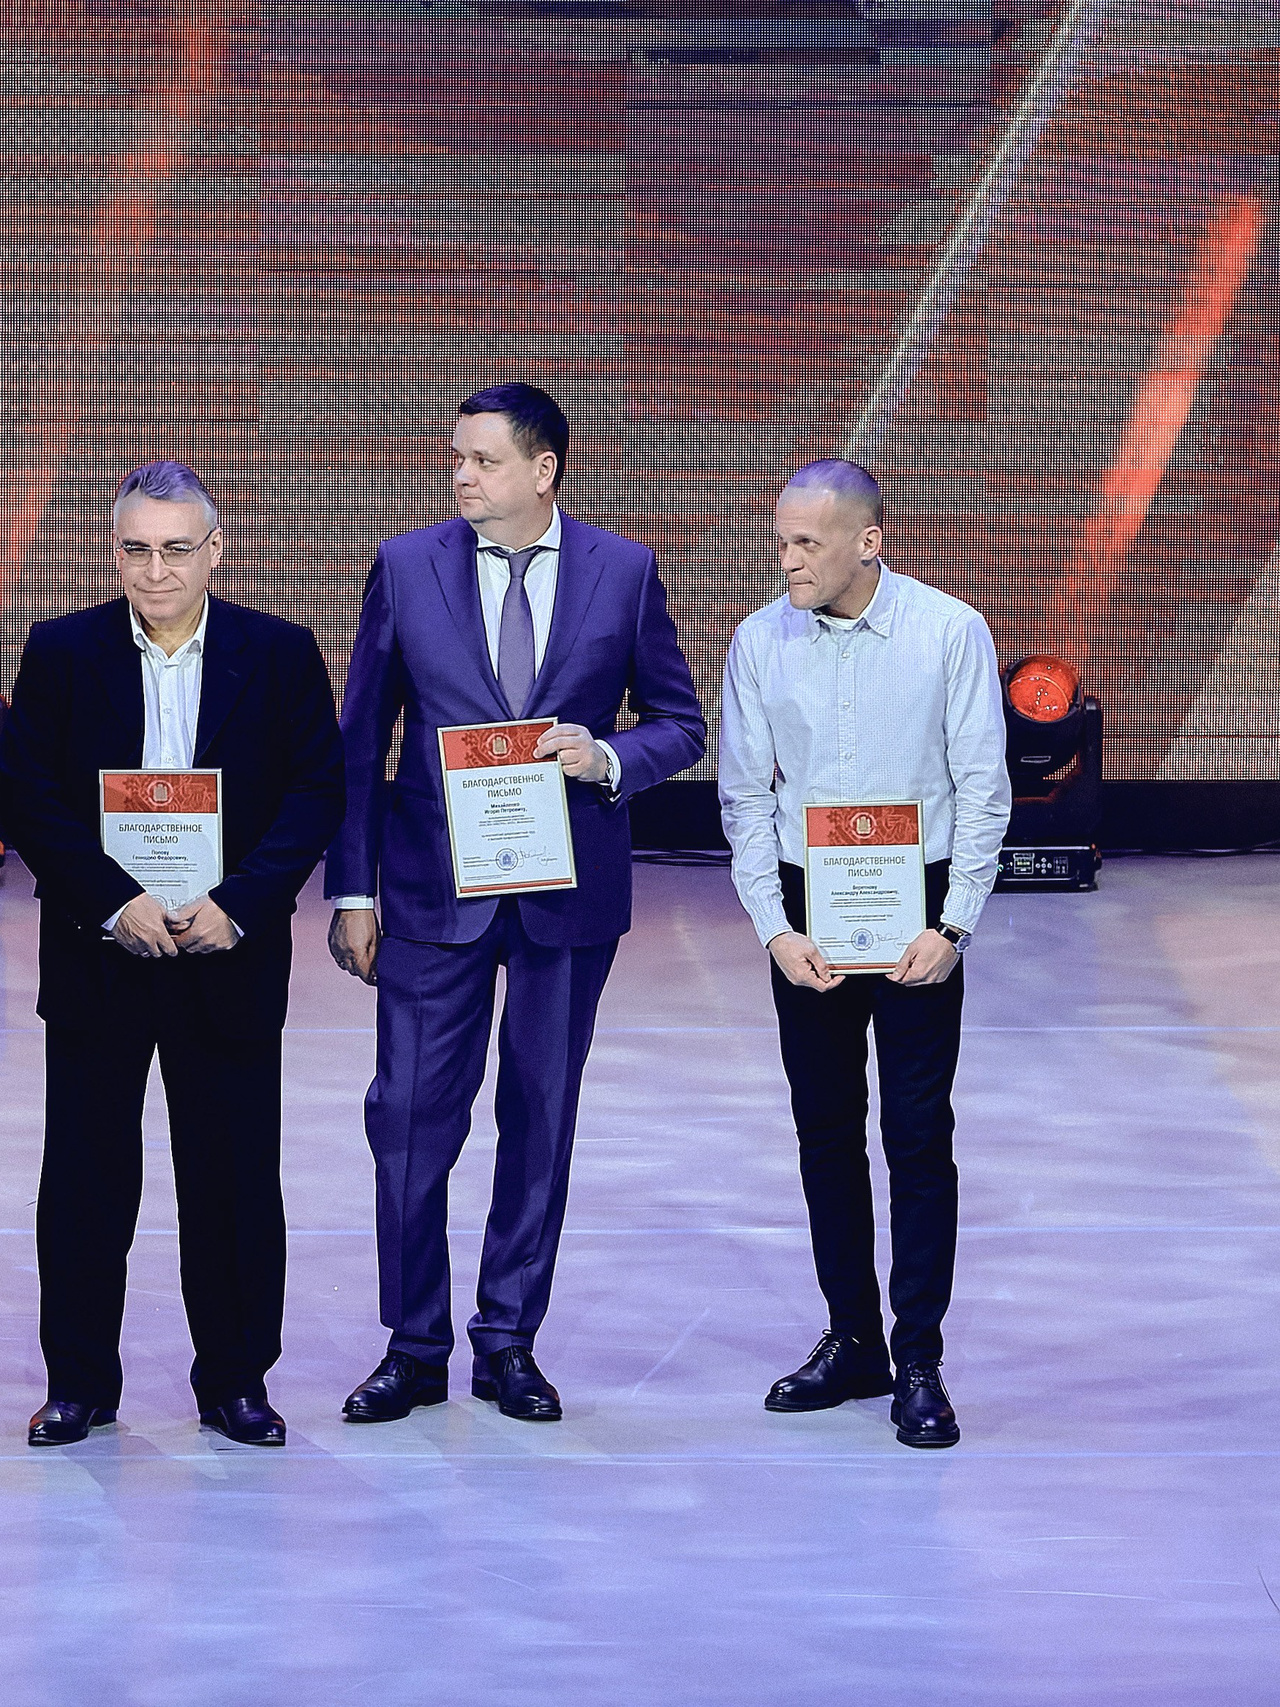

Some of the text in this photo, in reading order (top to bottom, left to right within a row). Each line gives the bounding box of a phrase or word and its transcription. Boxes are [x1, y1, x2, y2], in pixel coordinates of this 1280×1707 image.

[462, 773, 545, 789] БЛАГОДАРСТВЕННОЕ
[487, 787, 522, 798] ПИСЬМО
[118, 823, 203, 833] БЛАГОДАРСТВЕННОЕ
[143, 835, 179, 844] ПИСЬМО
[823, 855, 907, 867] БЛАГОДАРСТВЕННОЕ
[847, 868, 883, 877] ПИСЬМО
